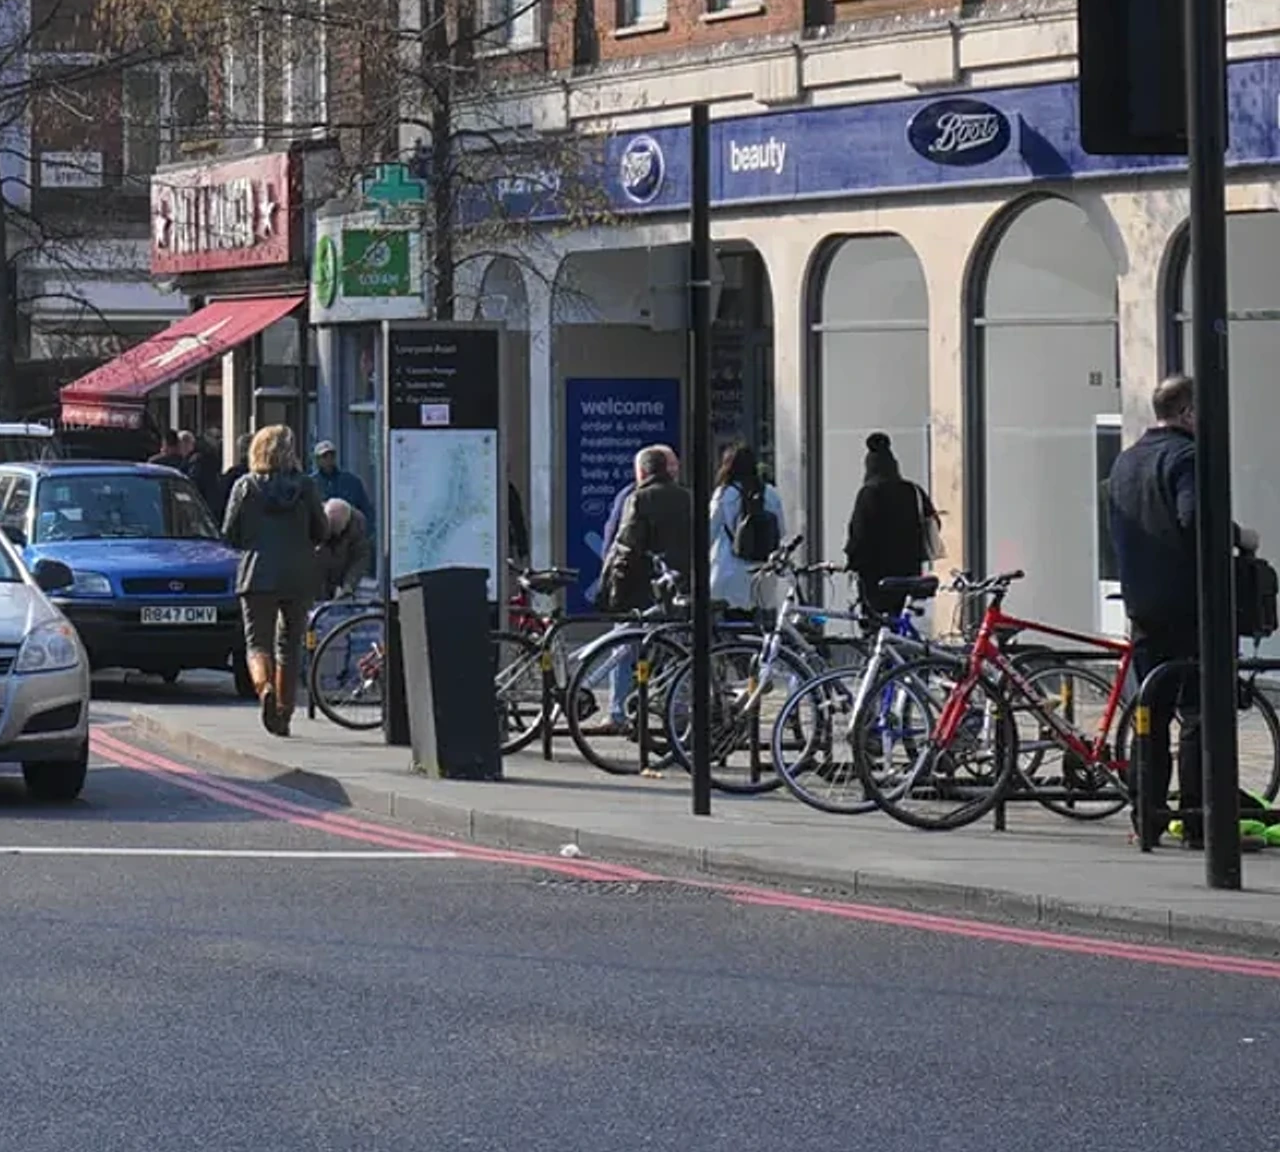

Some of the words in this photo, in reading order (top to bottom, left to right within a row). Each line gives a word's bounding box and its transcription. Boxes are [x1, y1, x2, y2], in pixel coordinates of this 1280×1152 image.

[928, 112, 999, 151] Boots
[730, 136, 786, 174] beauty
[580, 397, 664, 415] welcome
[581, 421, 613, 431] order
[616, 422, 624, 431] &
[627, 421, 666, 431] collect
[581, 437, 642, 447] healthcare
[582, 467, 610, 480] baby
[582, 485, 615, 496] photo
[143, 607, 182, 623] R847
[185, 607, 216, 623] OMV
